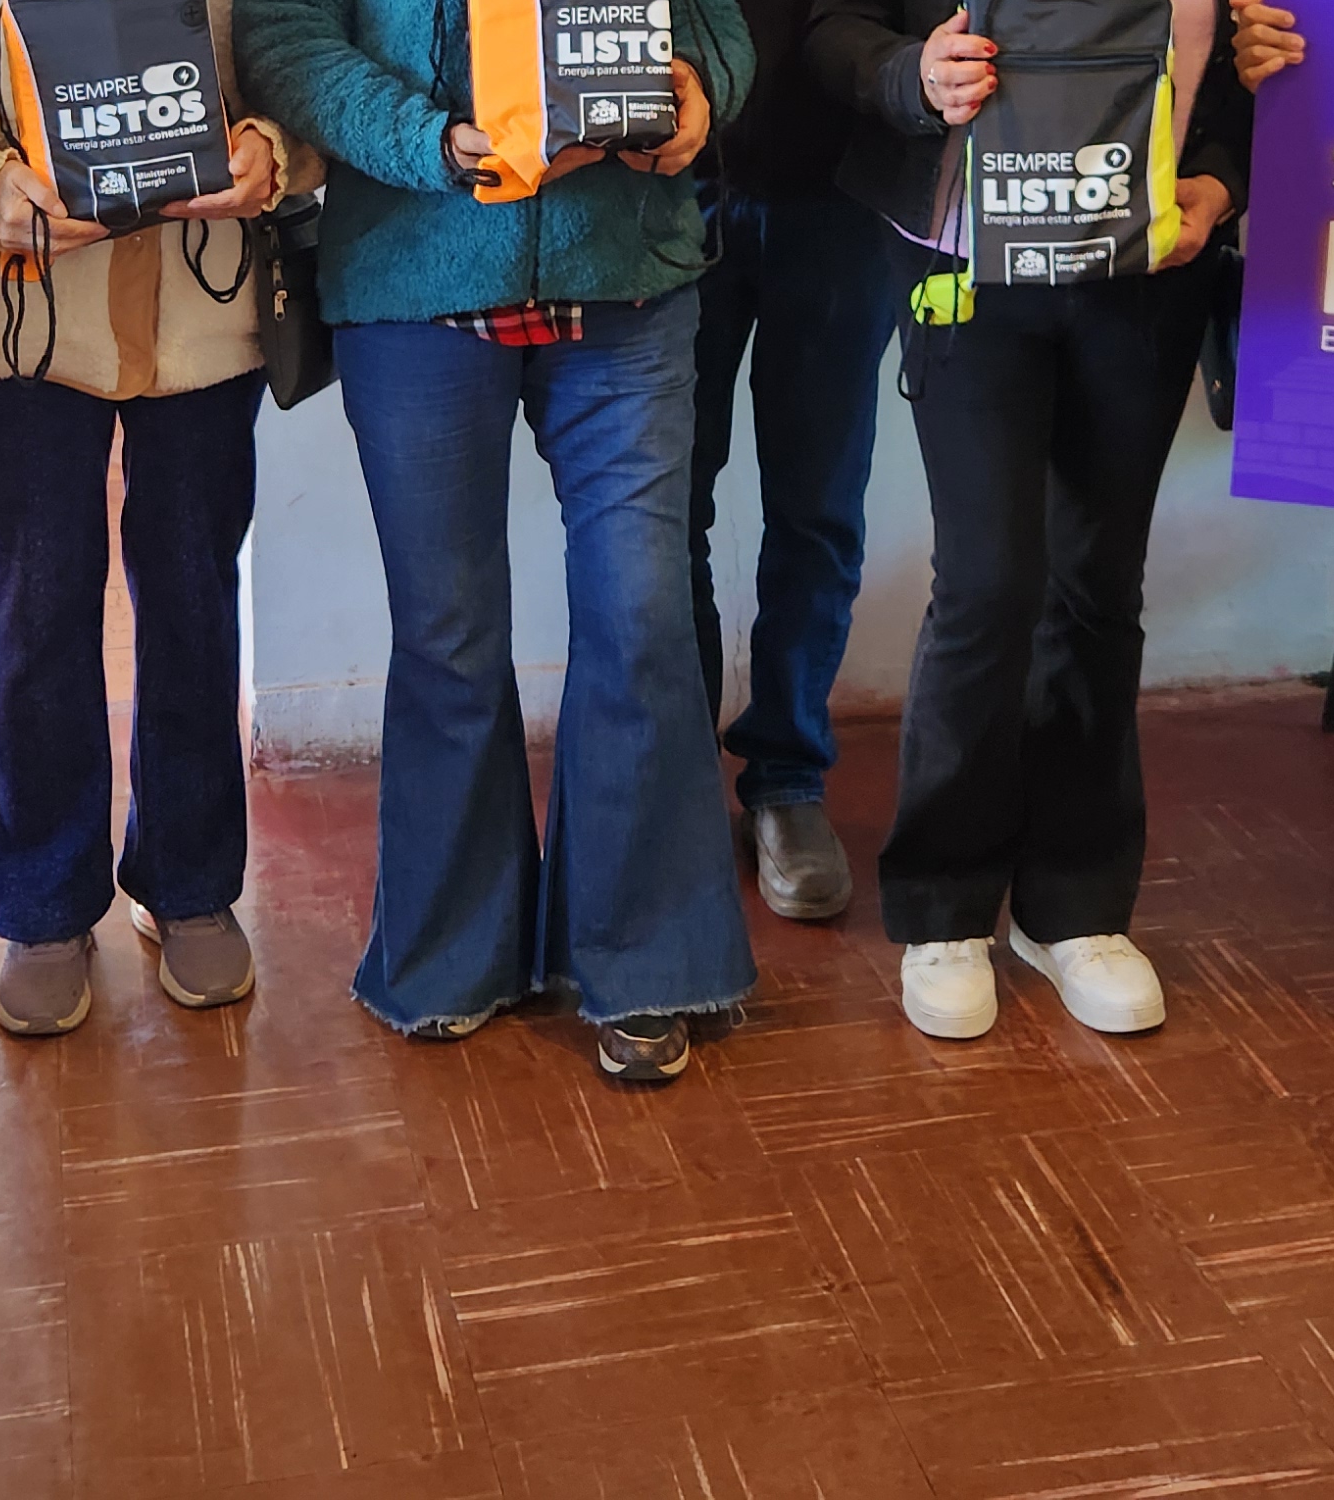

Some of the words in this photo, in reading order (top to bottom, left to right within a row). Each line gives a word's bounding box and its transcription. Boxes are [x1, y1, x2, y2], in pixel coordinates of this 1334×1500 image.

[557, 5, 646, 26] SIEMPRE
[597, 67, 618, 78] para
[620, 66, 644, 75] estar
[54, 76, 142, 103] SIEMPRE
[58, 90, 206, 140] LISTOS
[99, 137, 121, 150] para
[123, 134, 147, 145] estar
[148, 124, 209, 142] conectados
[135, 167, 175, 181] Ministerio
[176, 165, 187, 174] de
[982, 152, 1074, 173] SIEMPRE
[982, 173, 1131, 213] LISTOS
[1023, 215, 1046, 226] para
[1047, 214, 1071, 224] estar
